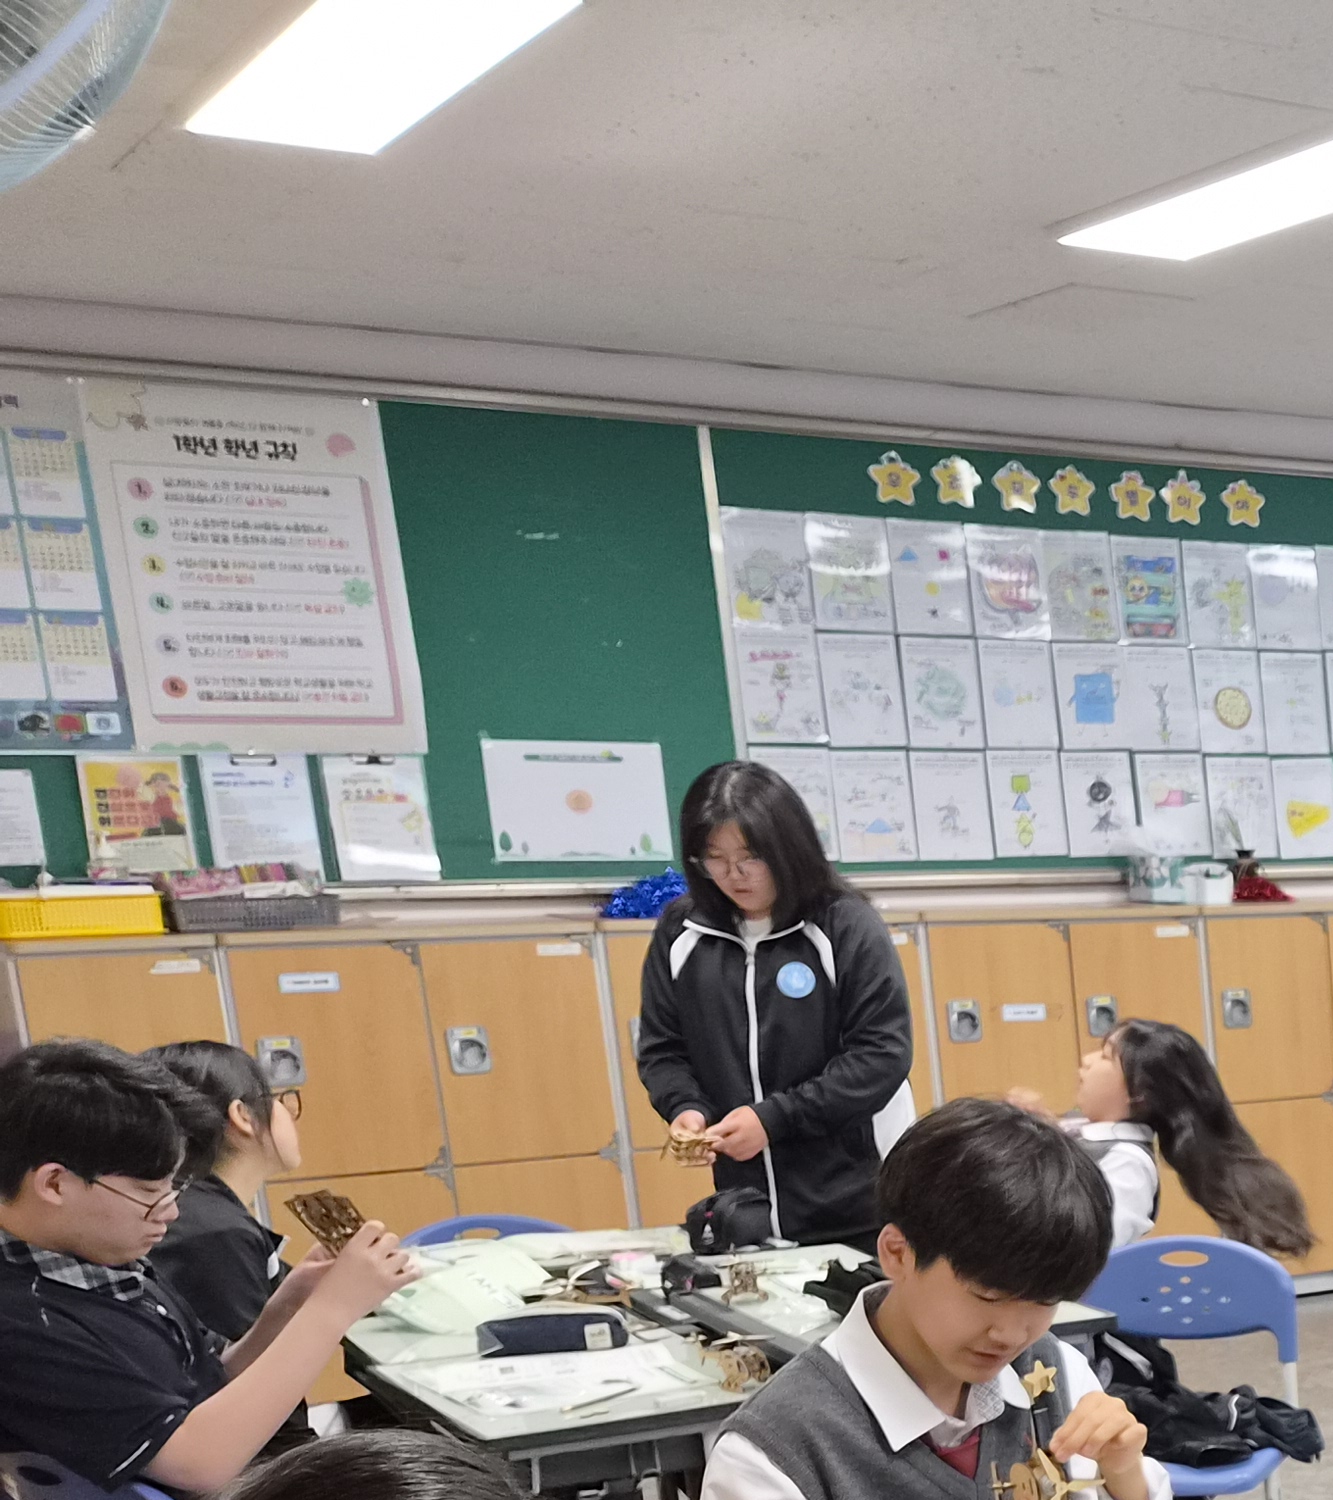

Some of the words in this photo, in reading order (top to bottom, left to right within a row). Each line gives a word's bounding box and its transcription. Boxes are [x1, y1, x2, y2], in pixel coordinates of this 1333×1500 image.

[172, 433, 218, 458] 1학년
[223, 438, 259, 460] 학년
[264, 440, 298, 461] 규칙
